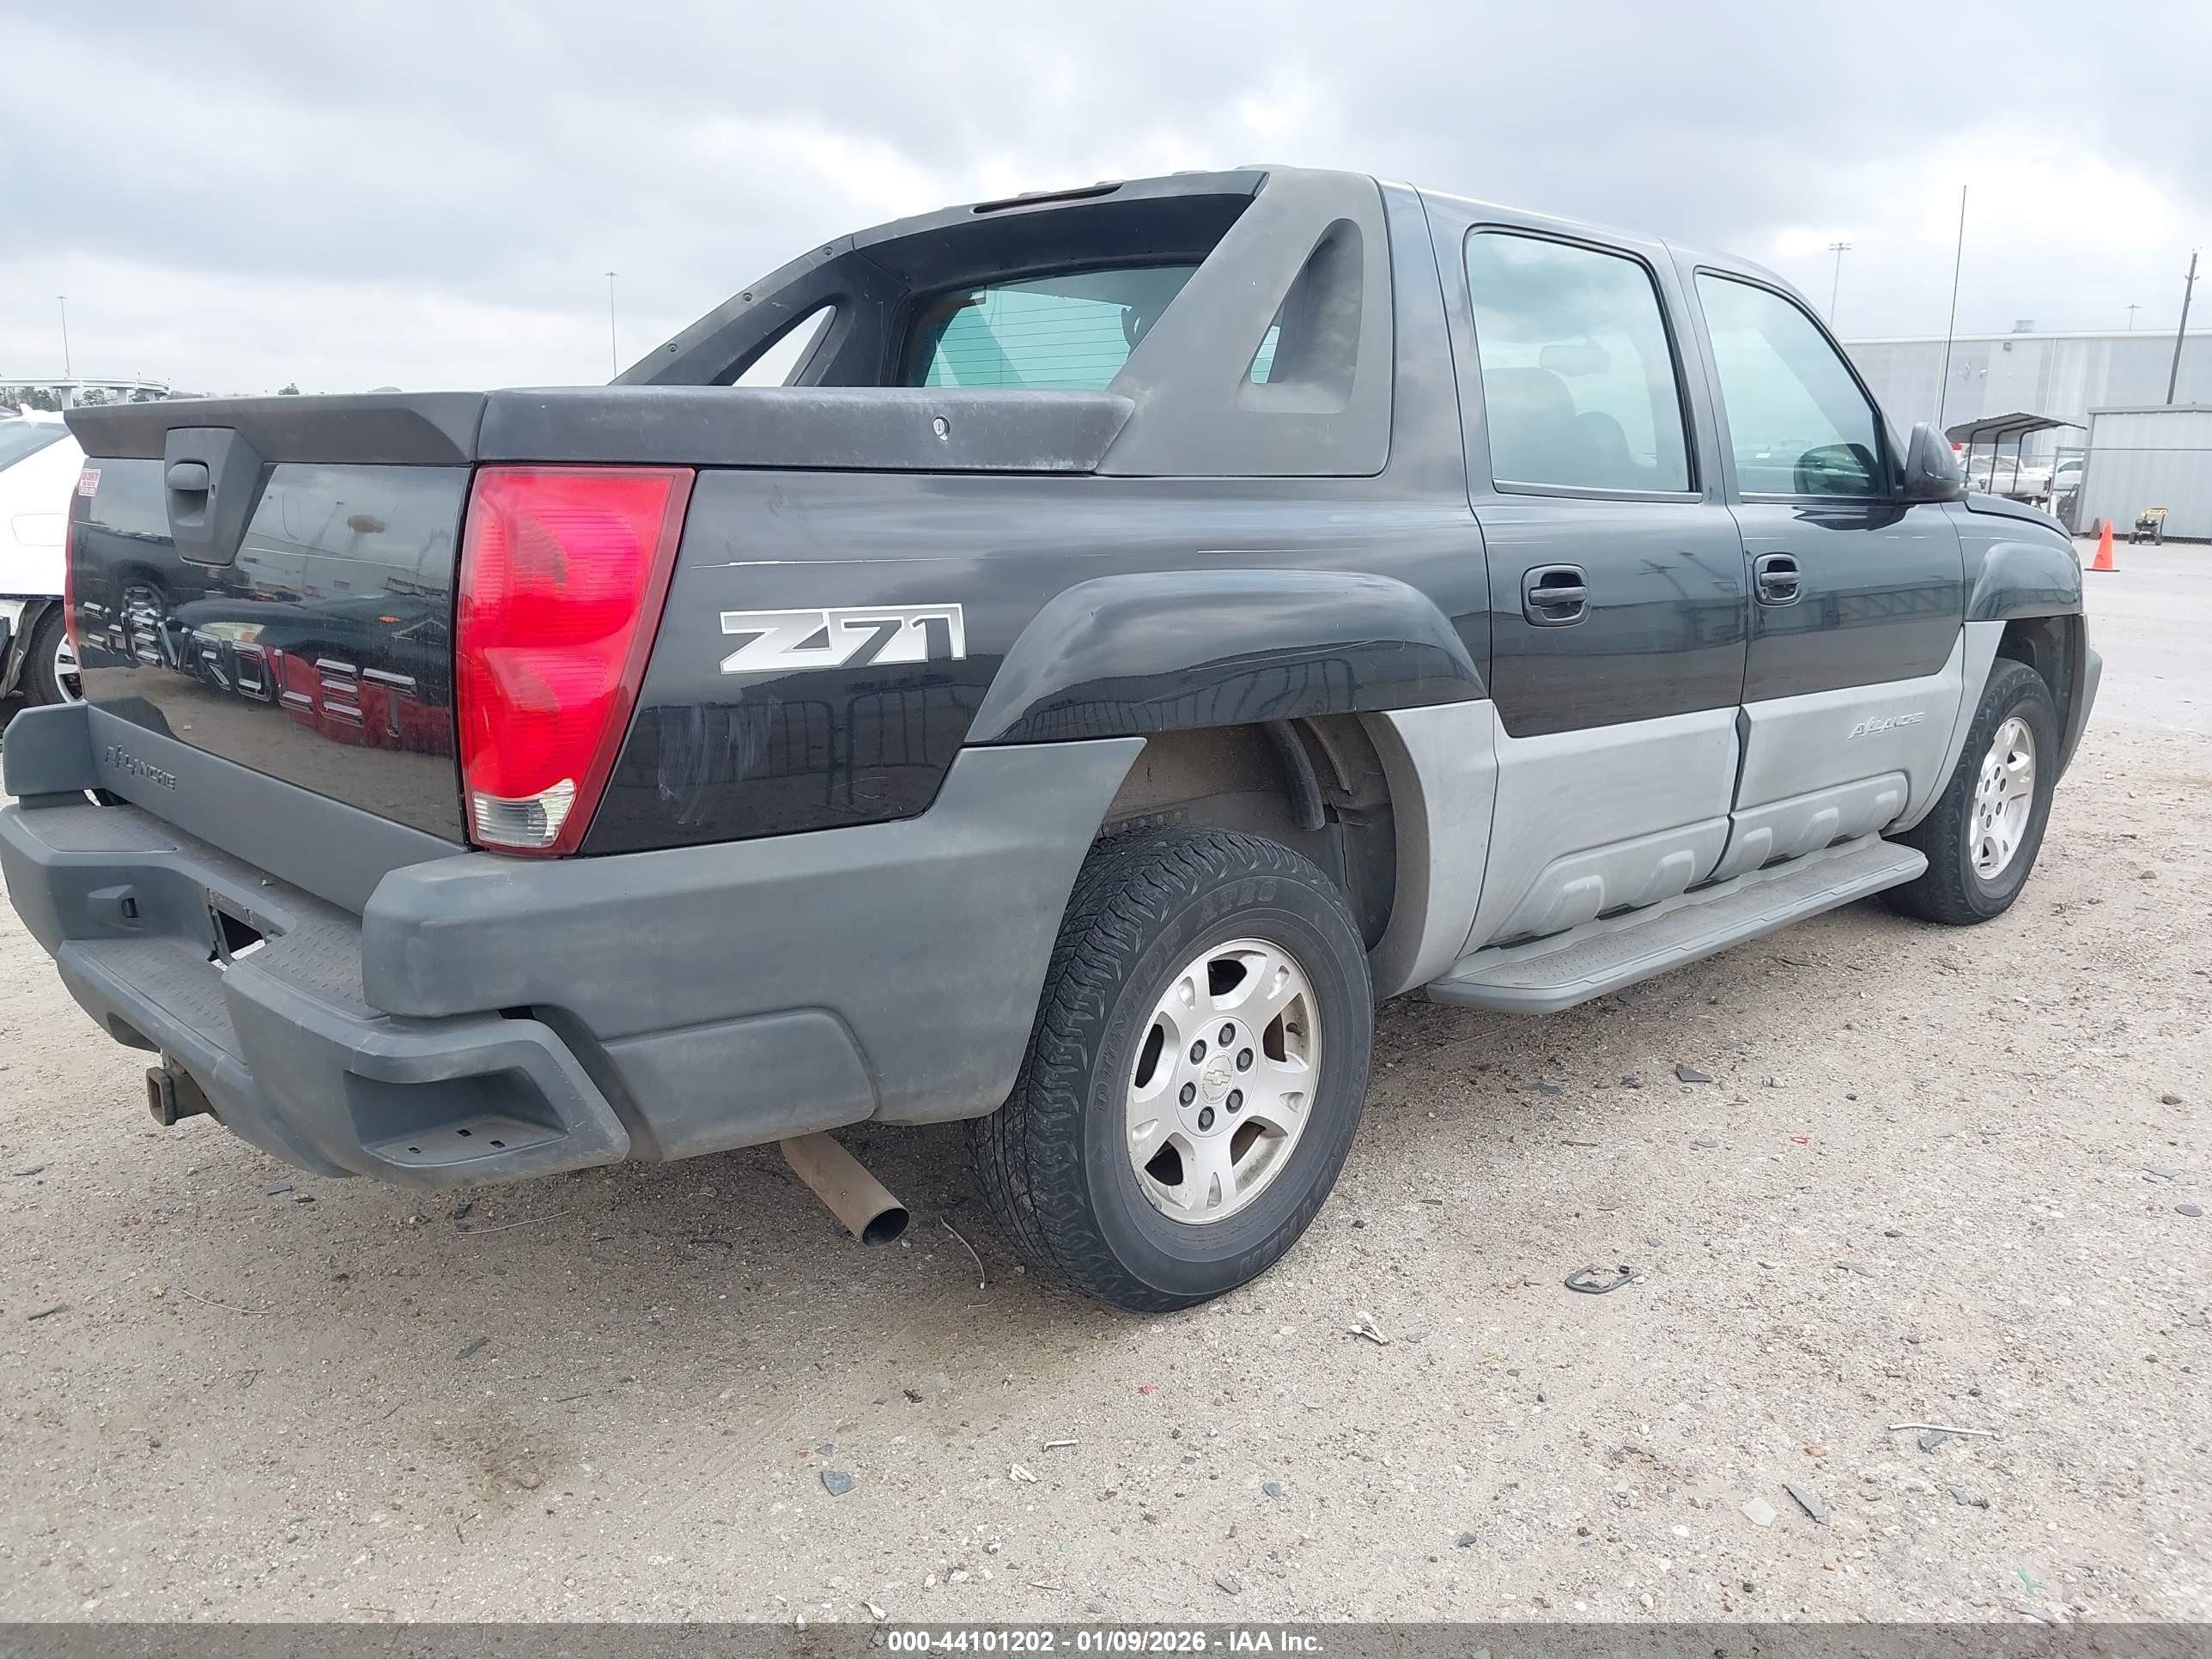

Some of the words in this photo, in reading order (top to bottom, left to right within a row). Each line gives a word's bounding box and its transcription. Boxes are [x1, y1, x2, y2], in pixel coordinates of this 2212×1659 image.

[83, 601, 417, 738] CHEVROLET
[720, 603, 967, 674] Z71
[105, 743, 177, 791] AVALANCHE
